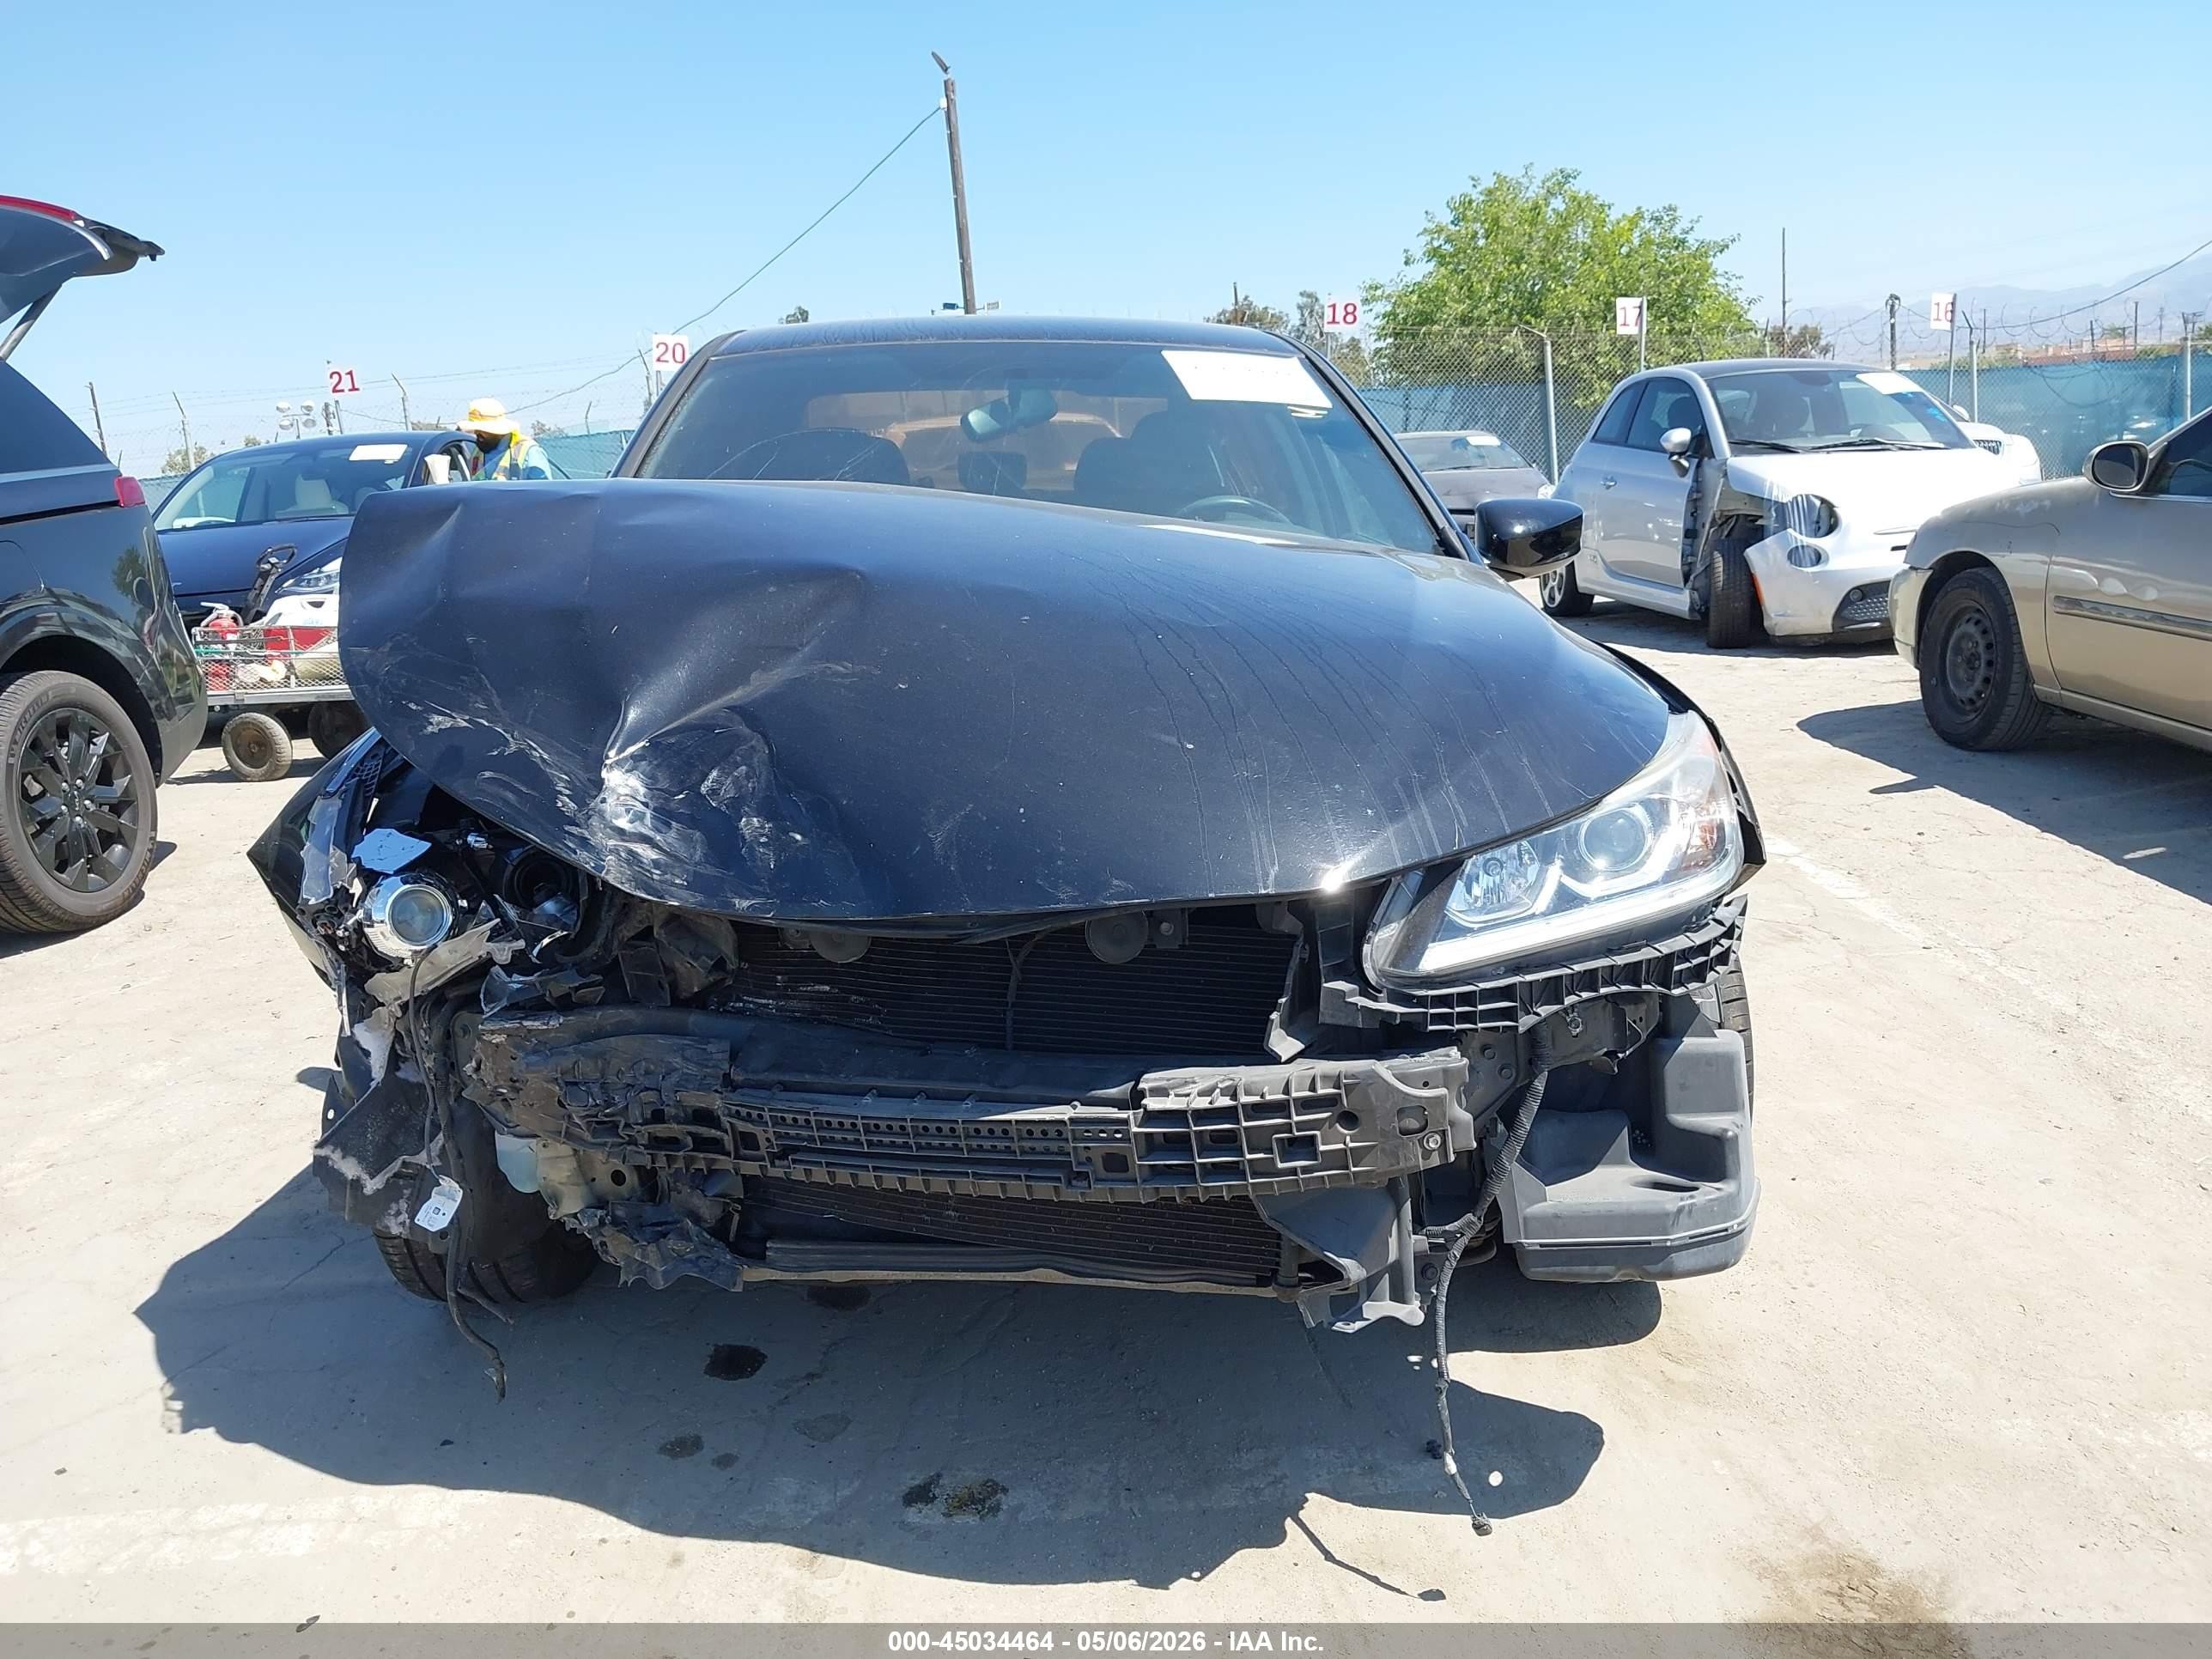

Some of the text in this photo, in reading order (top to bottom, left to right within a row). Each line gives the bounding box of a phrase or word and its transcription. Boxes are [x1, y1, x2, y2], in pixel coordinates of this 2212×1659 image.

[1327, 302, 1358, 325] 18
[1620, 306, 1642, 327] 17
[655, 342, 685, 364] 20
[329, 369, 360, 393] 21
